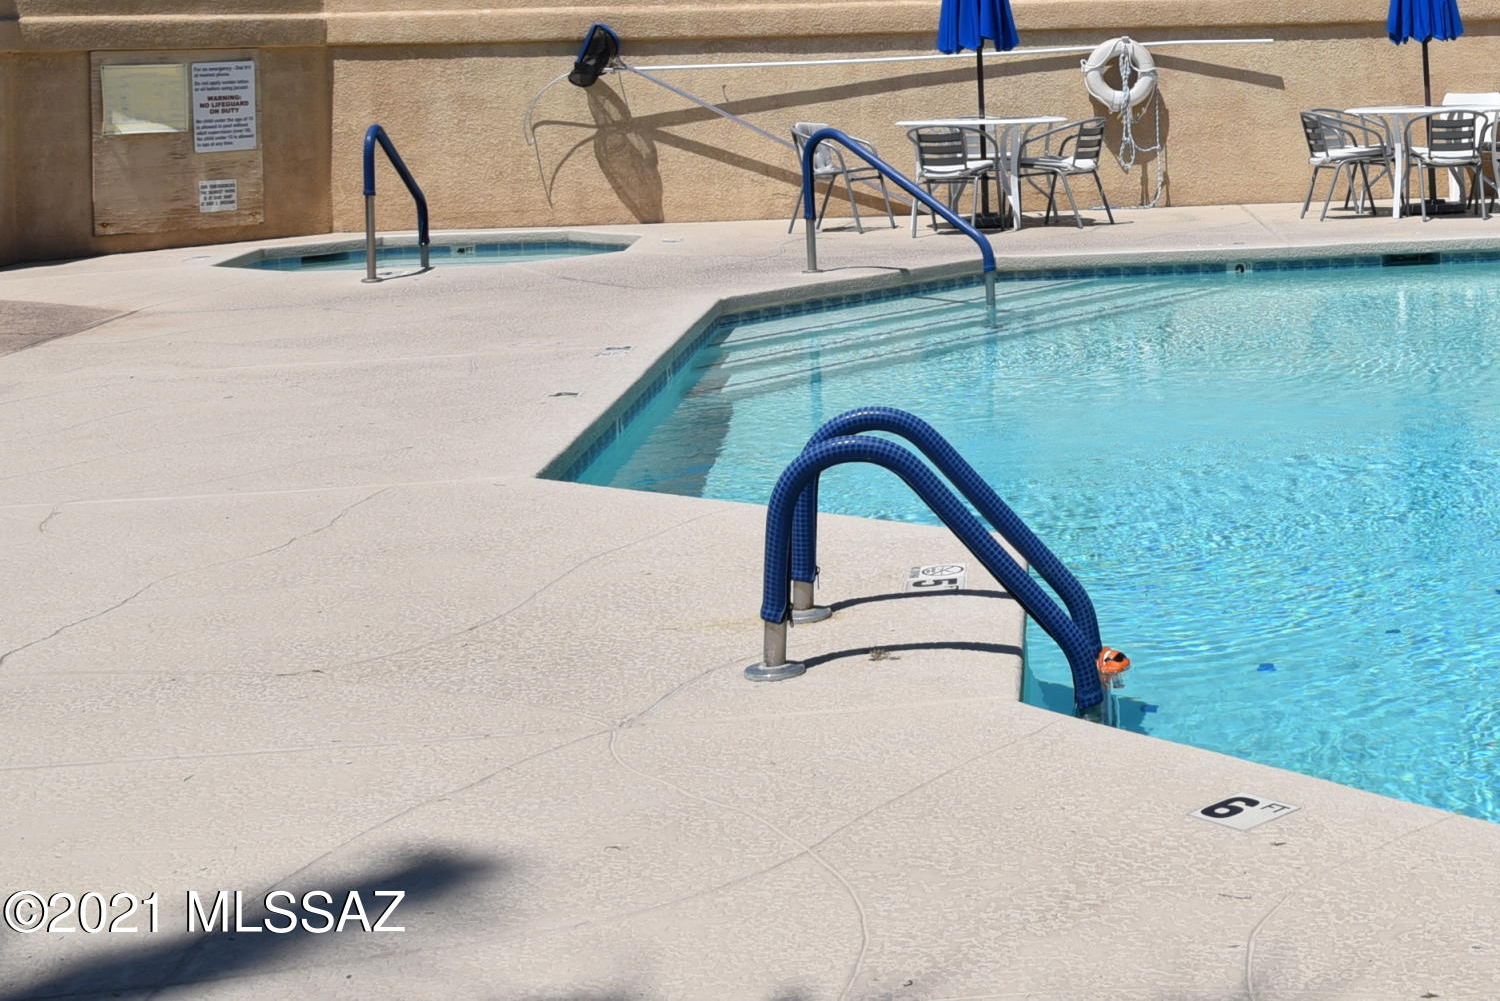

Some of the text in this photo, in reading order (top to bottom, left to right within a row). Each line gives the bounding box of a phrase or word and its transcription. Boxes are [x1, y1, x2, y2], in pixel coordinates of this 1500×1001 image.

[211, 100, 249, 108] LIFEGUARD
[1200, 796, 1291, 819] 6 FT
